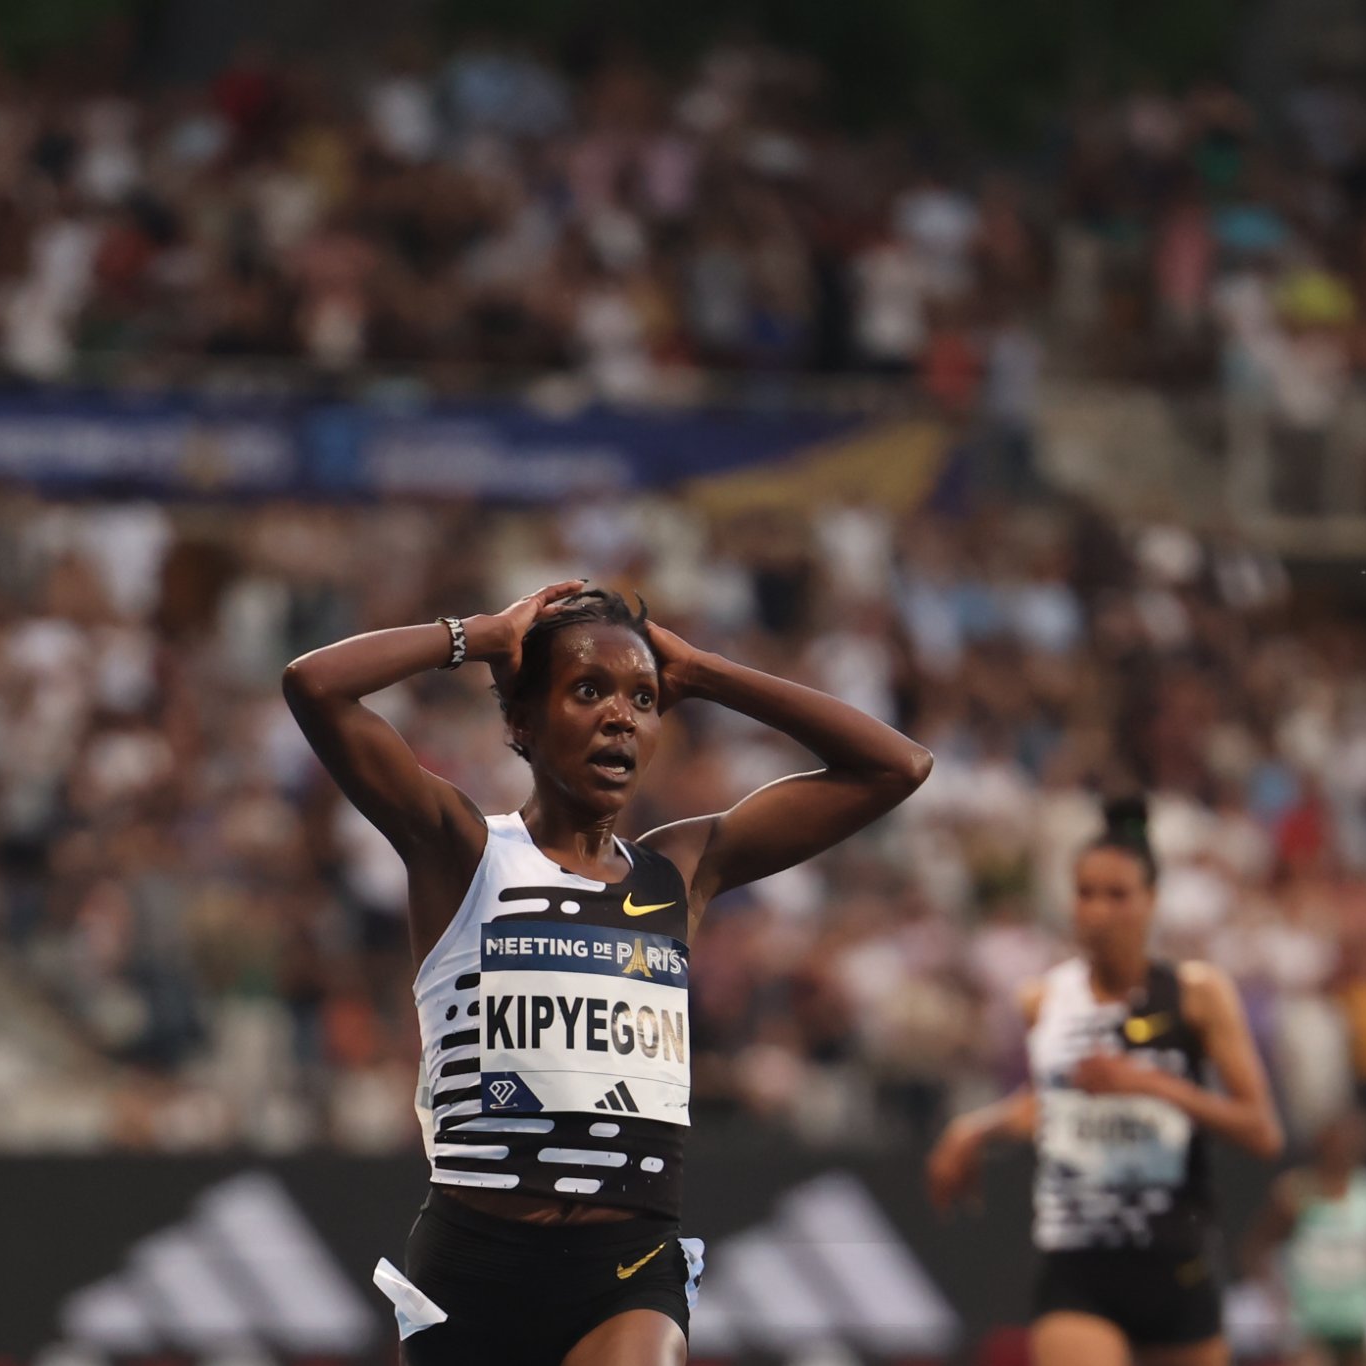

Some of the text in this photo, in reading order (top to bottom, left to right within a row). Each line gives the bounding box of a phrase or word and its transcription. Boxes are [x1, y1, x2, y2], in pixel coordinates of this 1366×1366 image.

[486, 937, 682, 977] MEETING DE PARIS
[486, 995, 685, 1065] KIPYEGON
